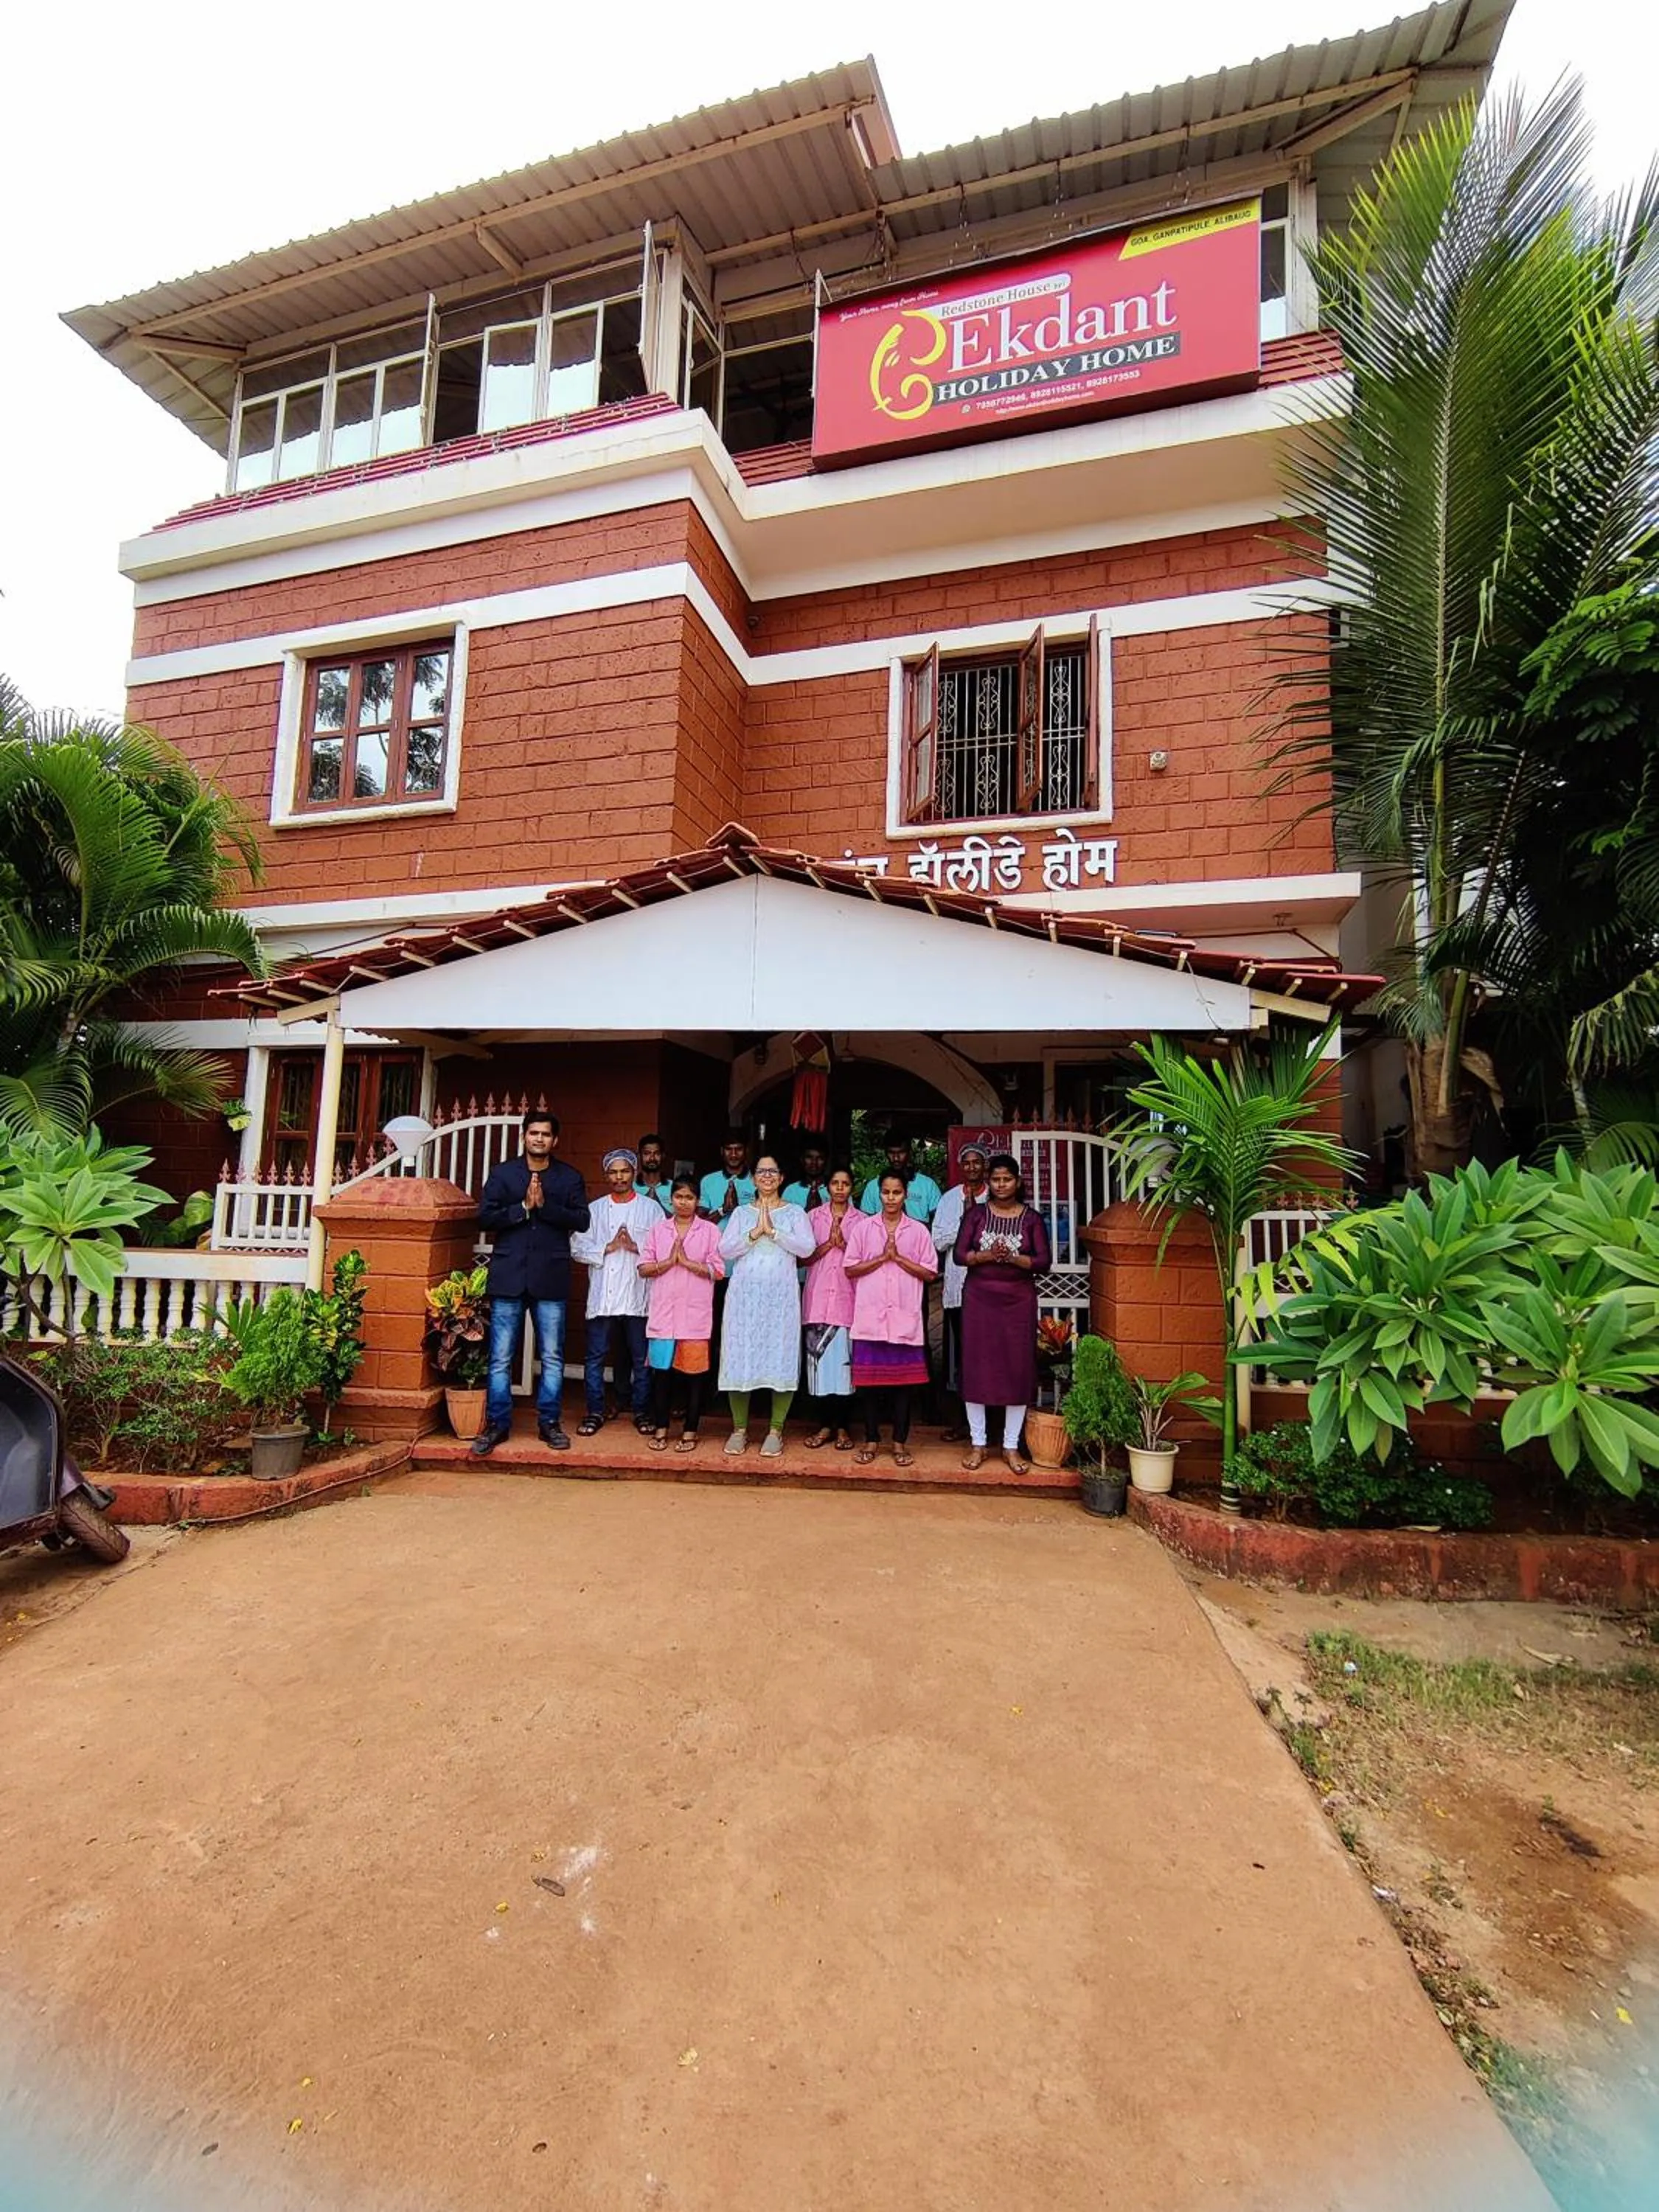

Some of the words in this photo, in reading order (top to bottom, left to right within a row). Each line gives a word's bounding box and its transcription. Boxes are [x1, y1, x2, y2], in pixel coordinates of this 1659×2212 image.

[941, 293, 1004, 316] Redstone
[1007, 282, 1051, 301] House
[947, 281, 1178, 373] Ekdant
[937, 357, 1073, 402] HOLIDAY
[1080, 335, 1176, 372] HOME
[908, 835, 1026, 891] हॉलीडे
[1041, 828, 1118, 891] होम
